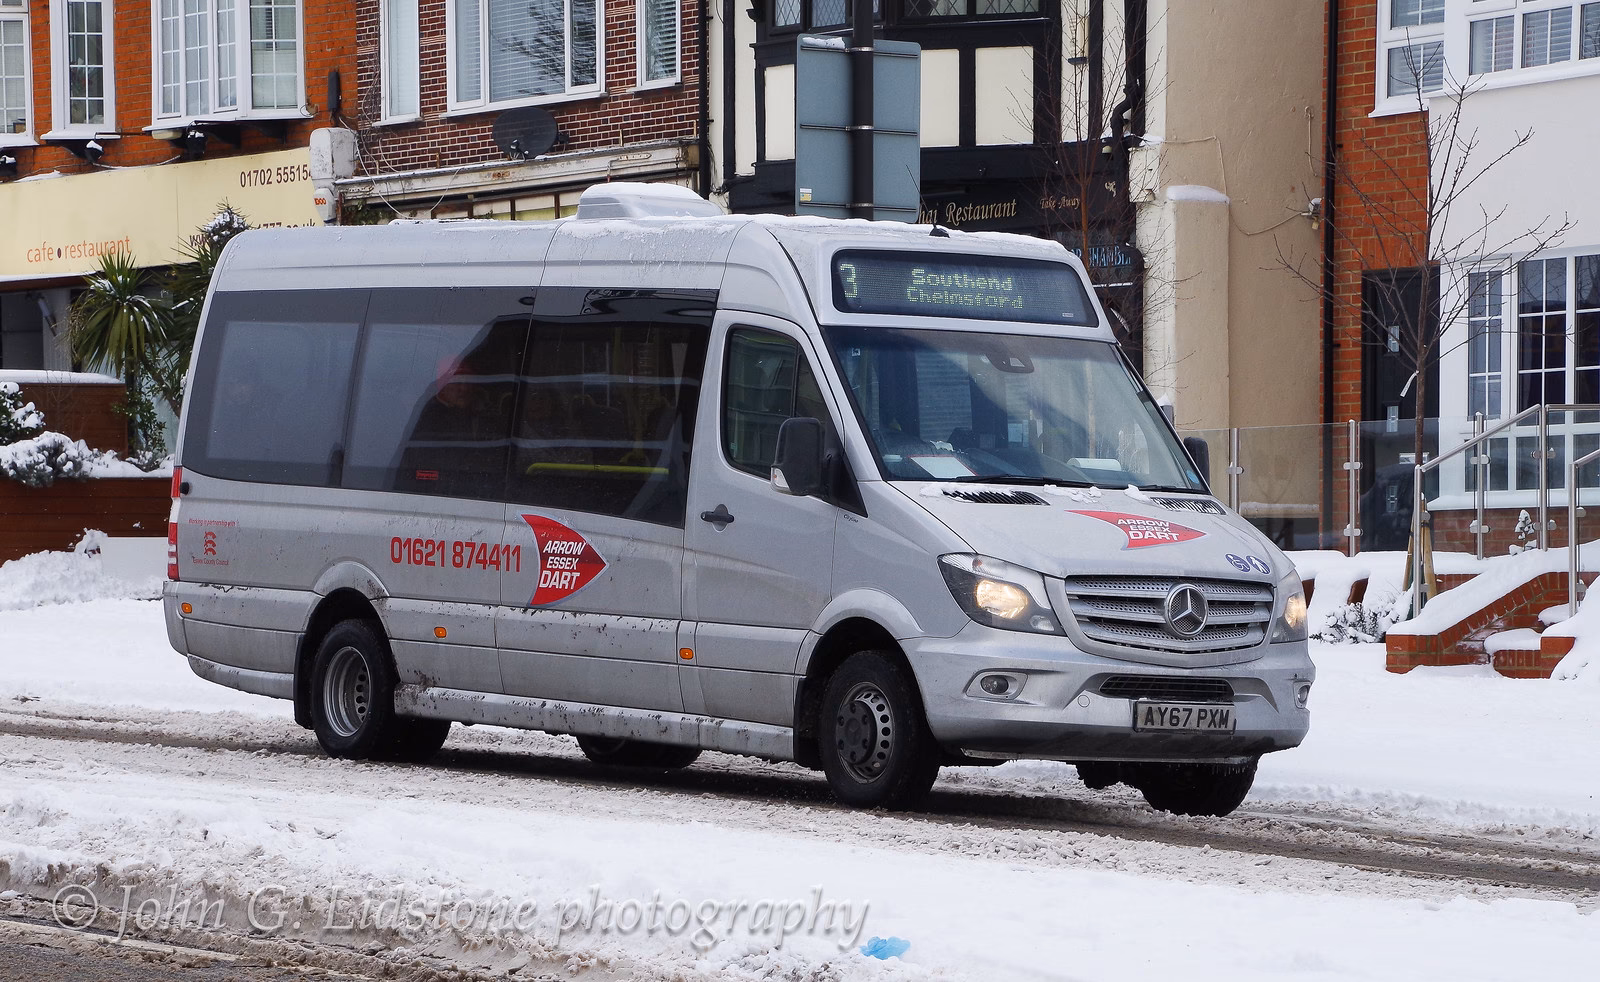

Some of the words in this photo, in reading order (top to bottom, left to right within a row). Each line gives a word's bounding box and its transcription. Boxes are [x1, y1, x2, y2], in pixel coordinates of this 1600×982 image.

[240, 168, 272, 188] 01702
[918, 202, 938, 224] hai
[946, 198, 1017, 226] Restaurant
[26, 240, 54, 263] cafe
[64, 235, 131, 259] restaurant
[840, 263, 858, 298] 3
[911, 268, 1013, 292] Southend
[906, 286, 1023, 309] Chelmsford
[1116, 518, 1170, 528] ARROW
[1129, 524, 1171, 533] ESSEX
[1128, 530, 1180, 541] DART
[390, 536, 446, 568] 01621
[451, 540, 522, 573] 874411
[542, 540, 586, 556] ARROW
[546, 556, 580, 570] ESSEX
[539, 570, 581, 590] DART
[1143, 706, 1193, 728] AY67
[1196, 708, 1230, 729] PXM
